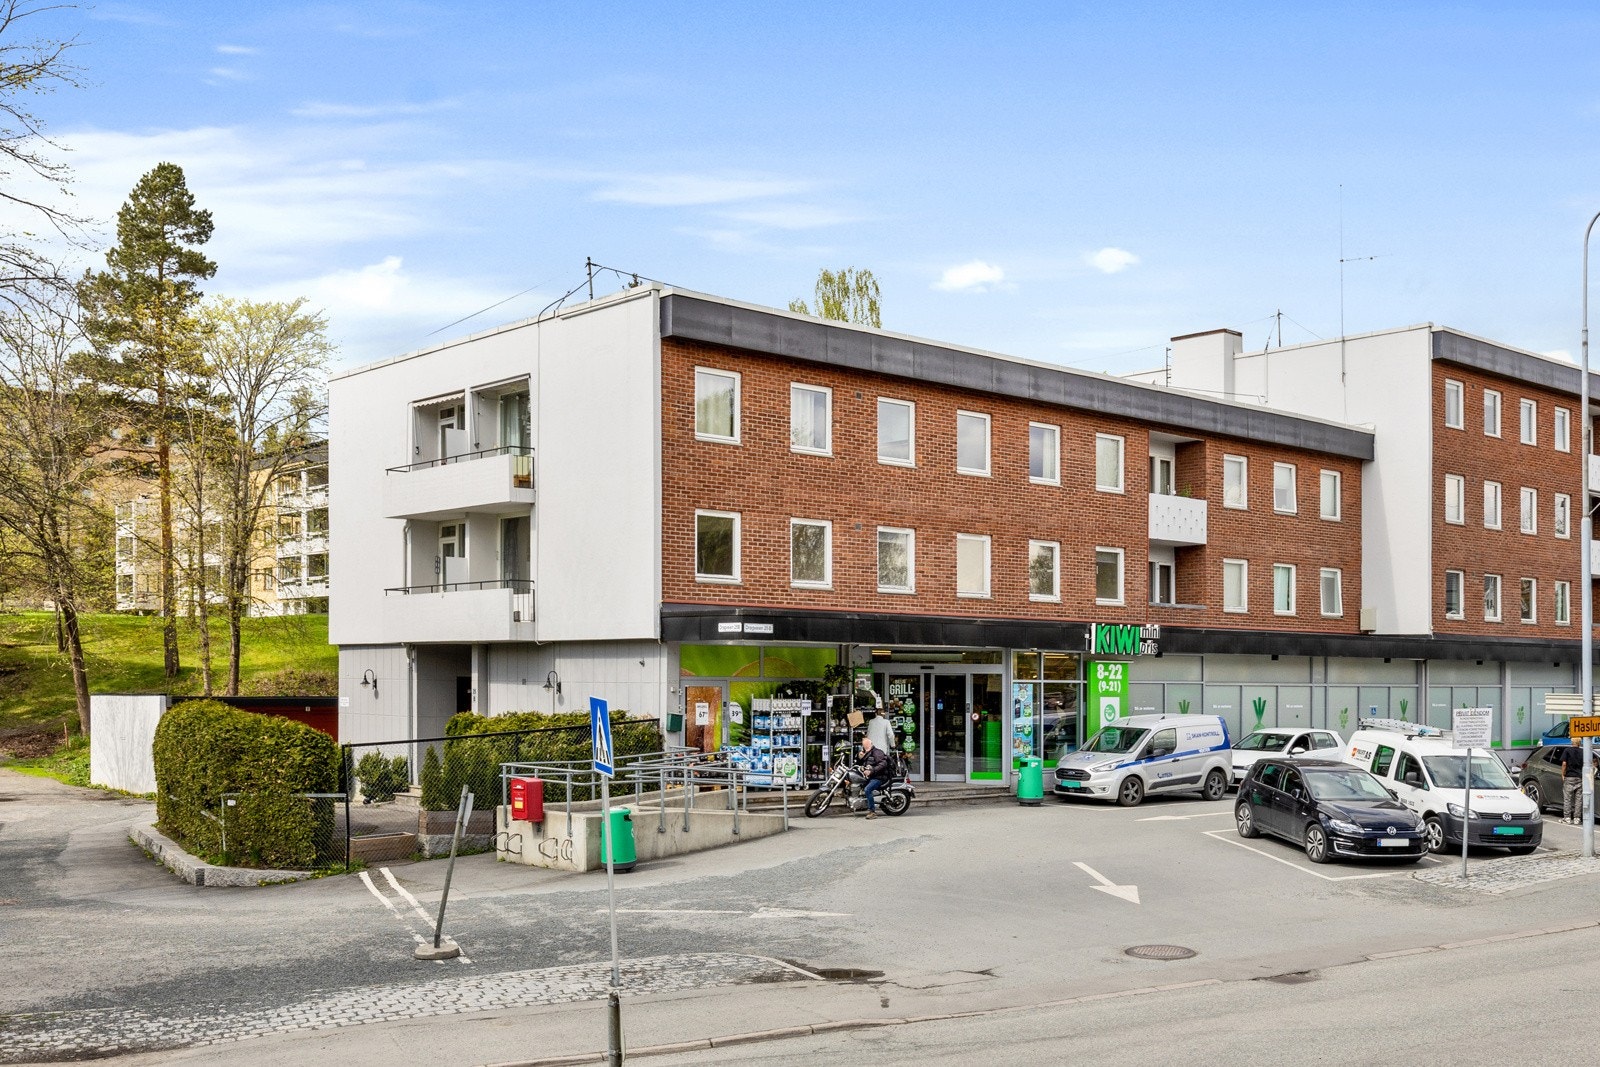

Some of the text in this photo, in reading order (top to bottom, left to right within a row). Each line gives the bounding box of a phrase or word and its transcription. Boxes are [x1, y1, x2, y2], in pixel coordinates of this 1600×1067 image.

[1095, 624, 1140, 654] KIWI
[1140, 624, 1160, 638] mini
[1138, 640, 1158, 656] pris
[1097, 664, 1122, 680] 8-22
[1098, 681, 1121, 693] (9-21)
